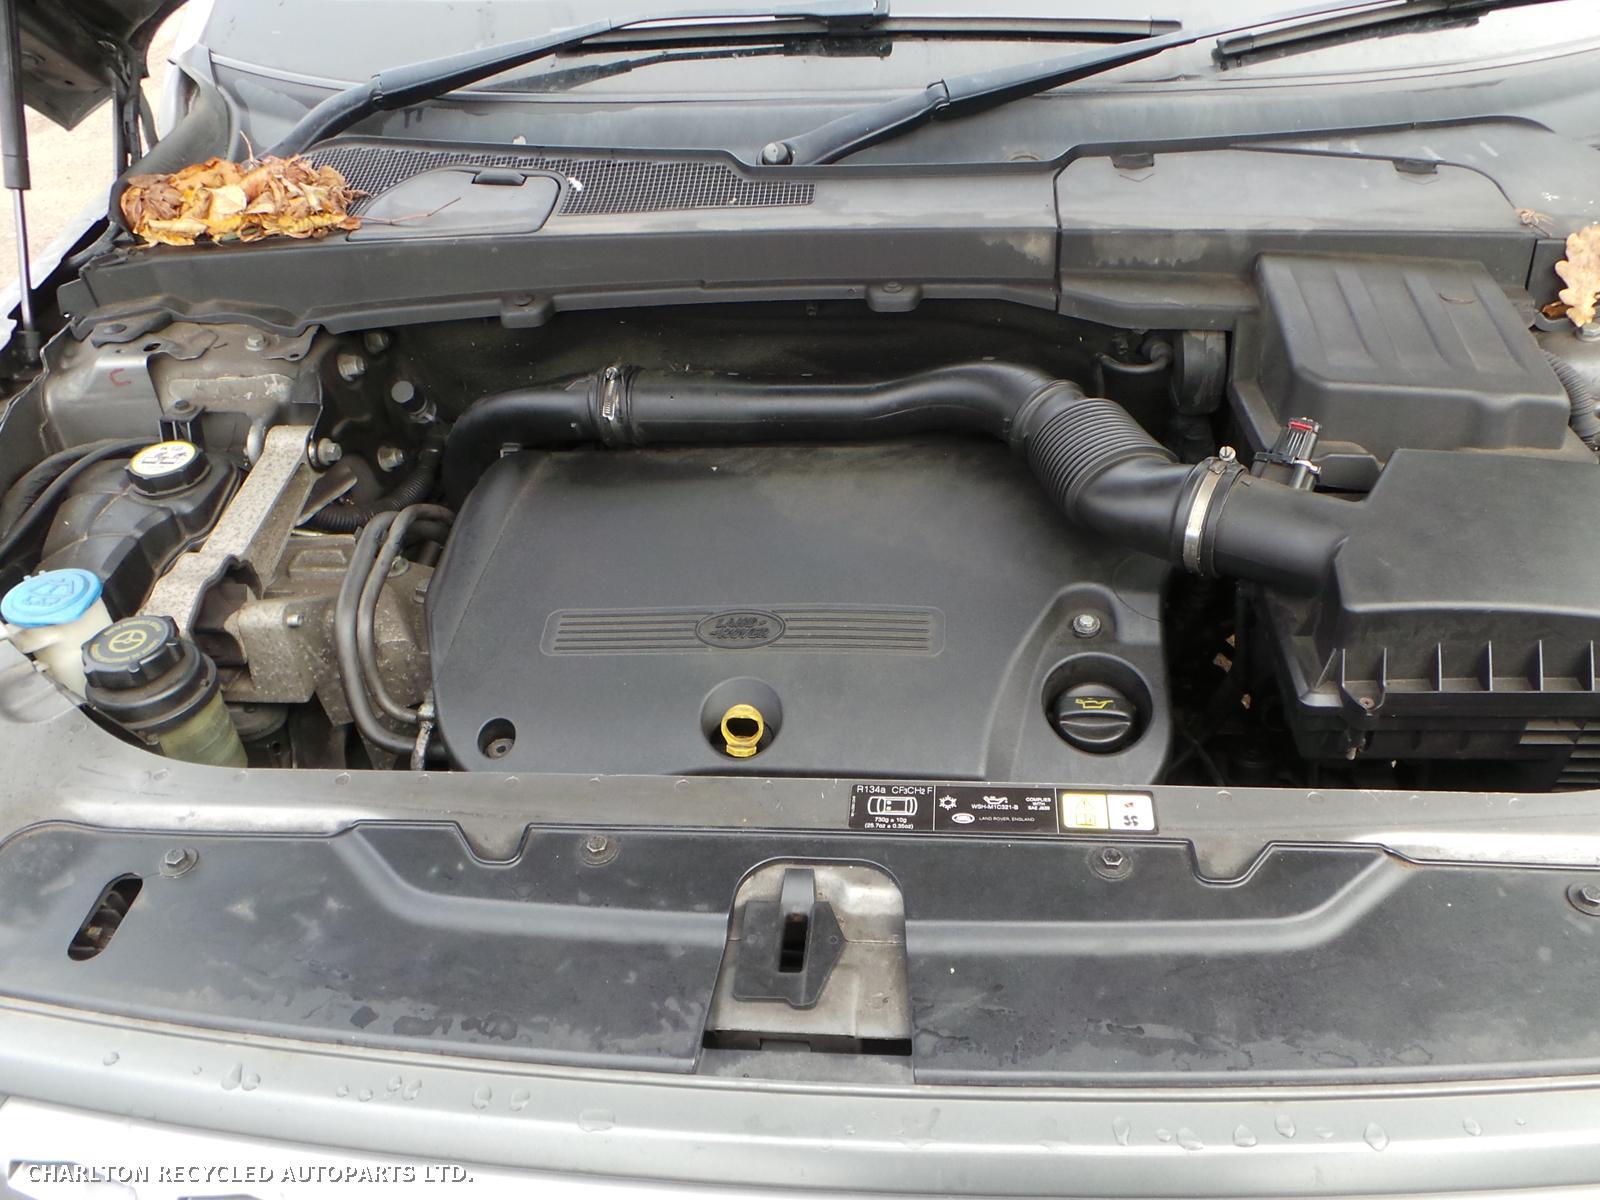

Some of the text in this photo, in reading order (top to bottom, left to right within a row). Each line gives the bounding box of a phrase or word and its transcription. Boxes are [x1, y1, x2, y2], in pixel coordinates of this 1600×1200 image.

[715, 617, 758, 628] LAND
[719, 627, 769, 639] ROVER
[857, 785, 886, 794] R134a
